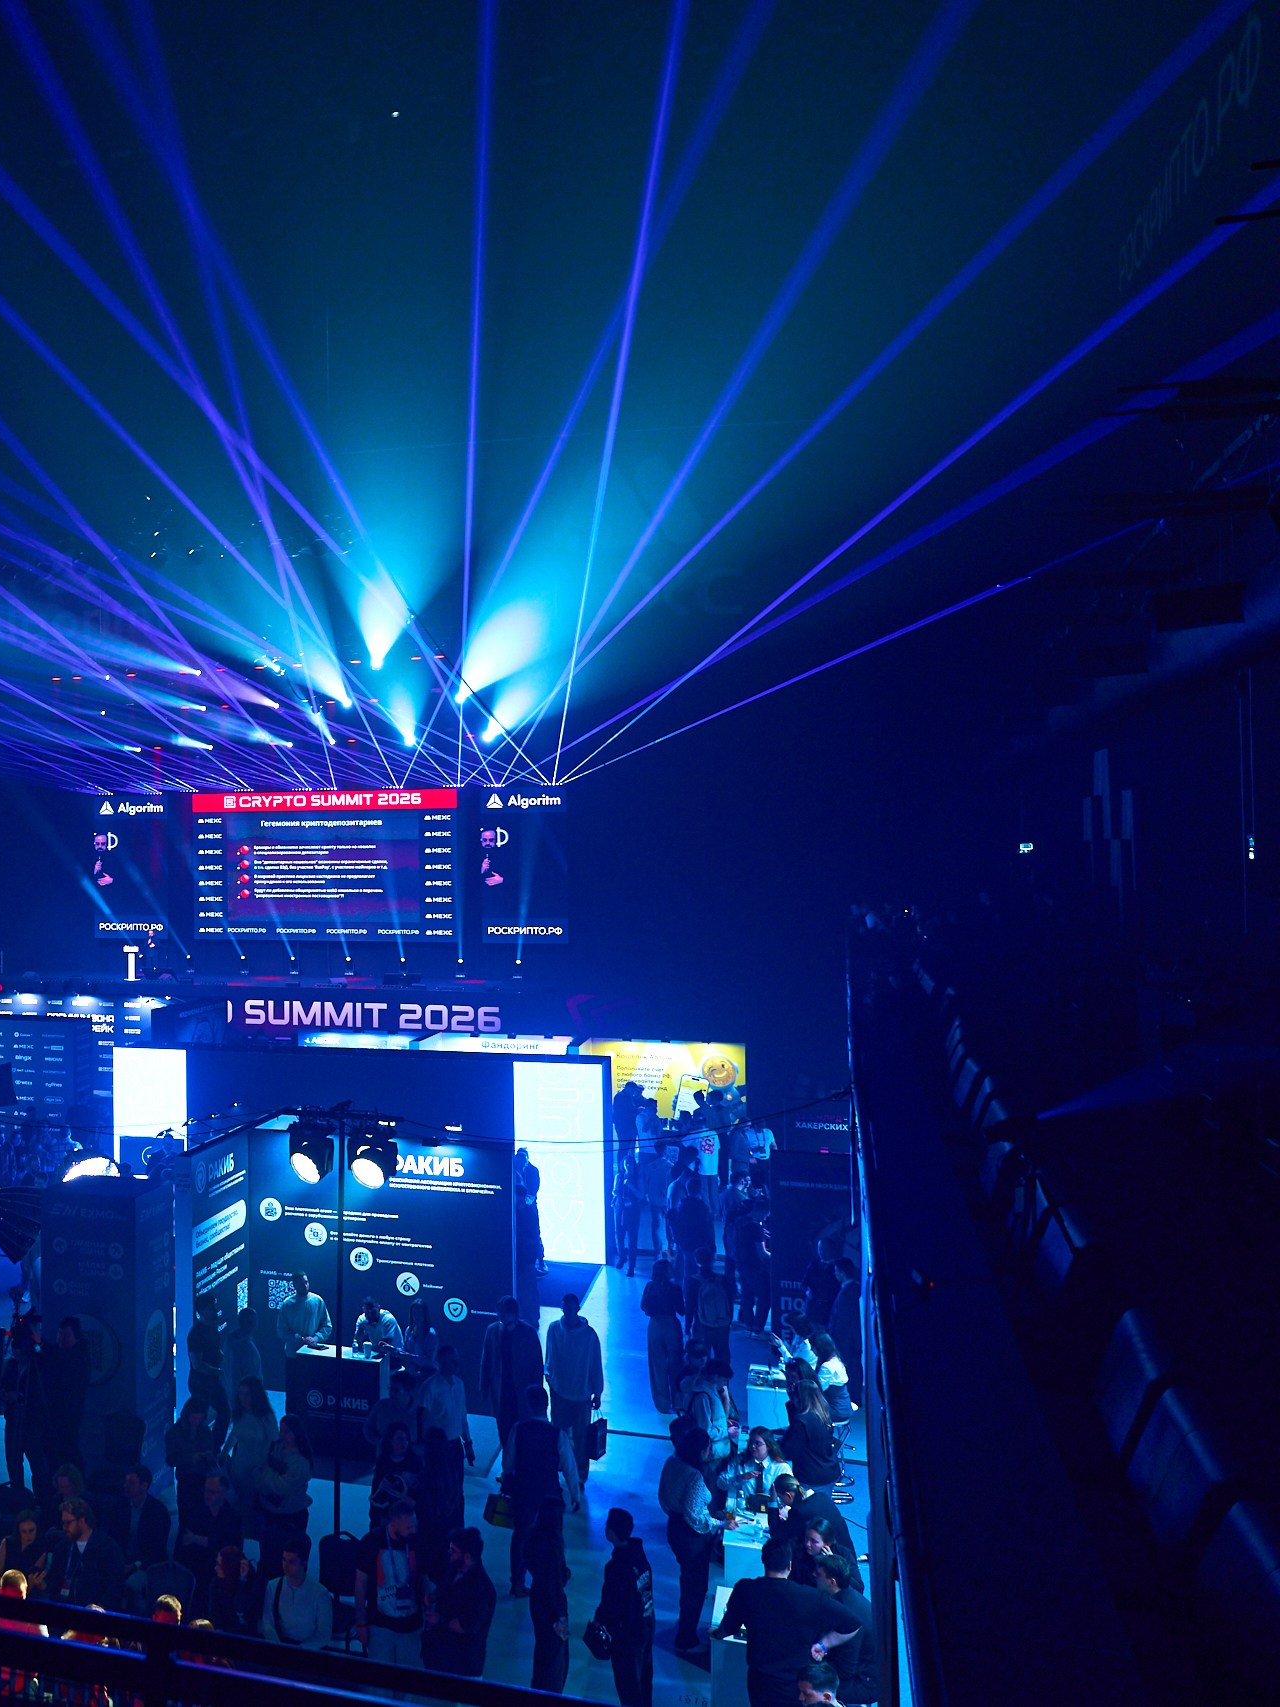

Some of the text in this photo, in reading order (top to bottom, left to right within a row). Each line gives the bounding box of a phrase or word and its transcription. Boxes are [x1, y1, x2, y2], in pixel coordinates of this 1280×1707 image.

[239, 793, 422, 808] CRYPTO SUMMIT 2026
[507, 794, 561, 809] Algoritm
[118, 802, 164, 815] Algoritm
[301, 819, 382, 828] криптодепозитариев
[99, 923, 164, 931] РОСКРИПТО.РФ
[488, 926, 563, 935] РОСКРИПТО.РФ
[245, 1000, 388, 1028] SUMMIT
[399, 1003, 501, 1032] 2026
[481, 1040, 540, 1052] Фандоринг
[795, 1121, 848, 1131] ХАКЕРСКИХ
[209, 1152, 235, 1182] РАКИБ
[80, 1208, 114, 1220] EXMO
[327, 1395, 369, 1410] РКИБ
